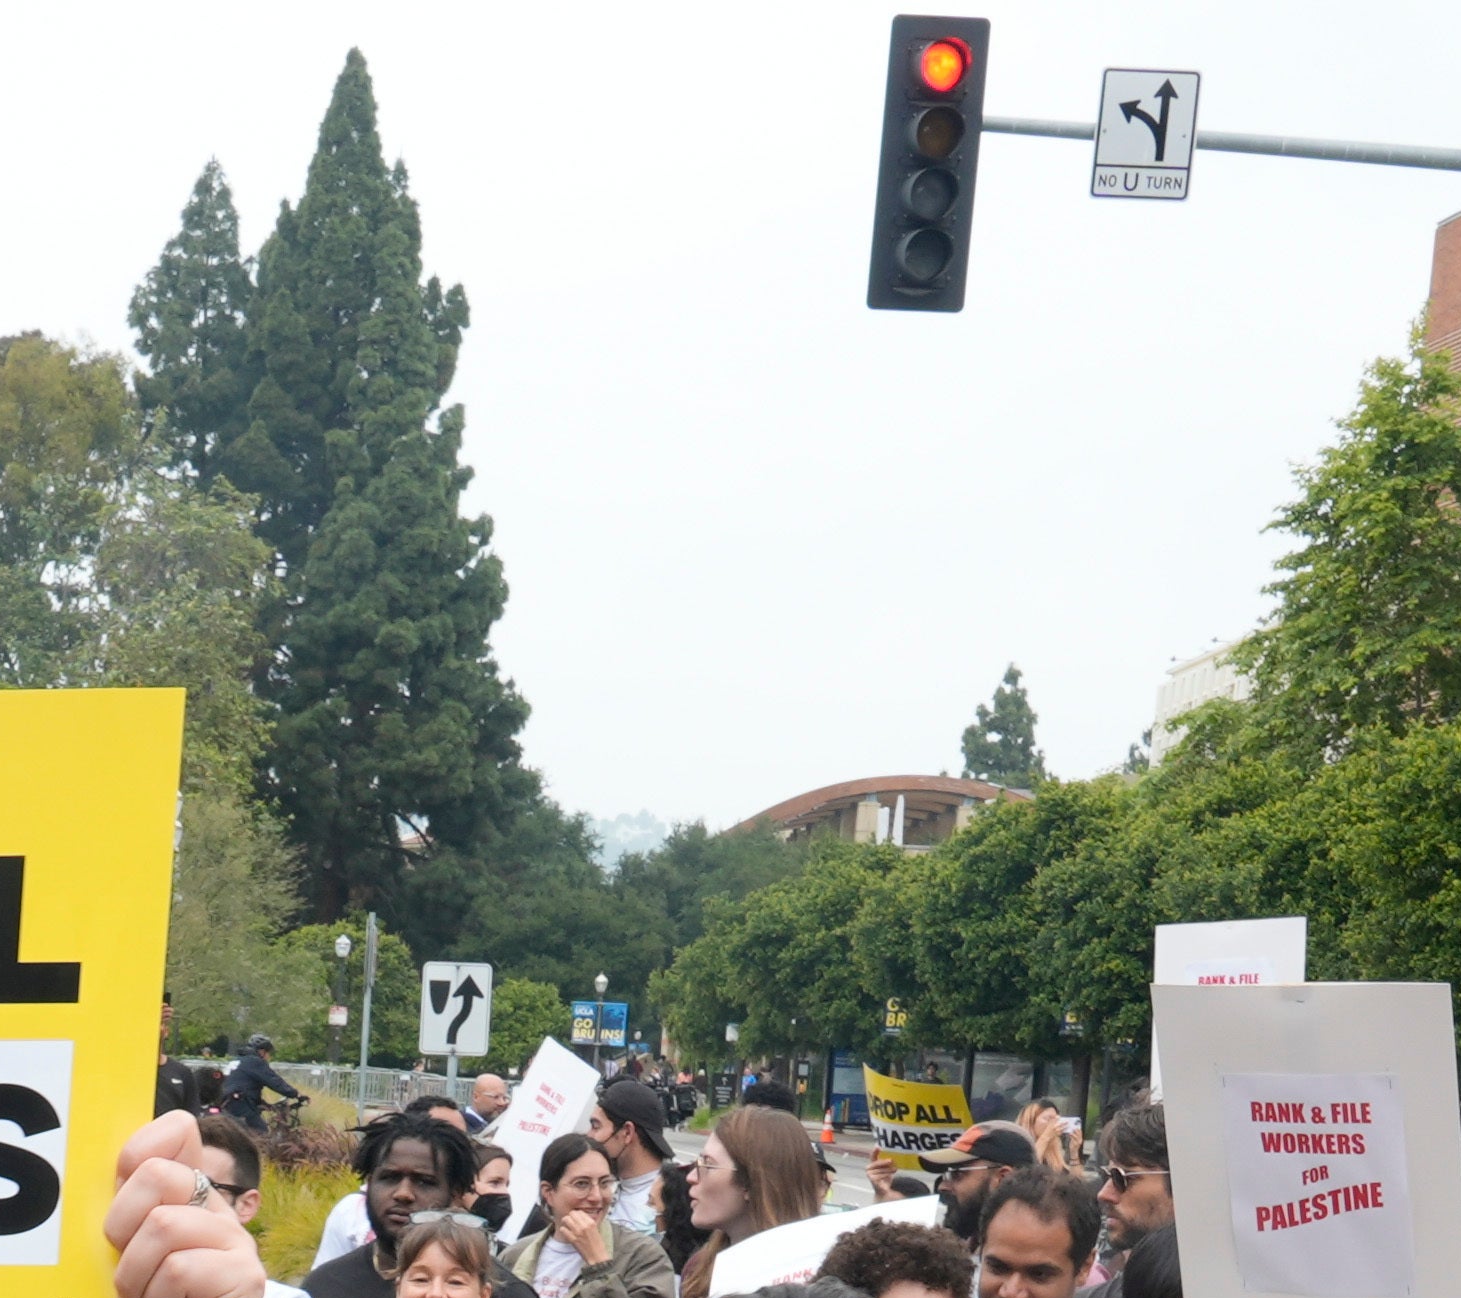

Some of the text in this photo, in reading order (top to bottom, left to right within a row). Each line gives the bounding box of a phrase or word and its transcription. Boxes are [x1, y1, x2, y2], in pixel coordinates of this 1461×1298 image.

[1098, 172, 1183, 192] NO U TURN
[1198, 974, 1225, 985] RANK
[1239, 973, 1260, 984] FILE
[573, 1017, 593, 1029] GO
[867, 1091, 962, 1123] ROP ALL
[1250, 1101, 1372, 1124] RANK & FILE
[876, 1127, 962, 1151] HARGES
[1261, 1132, 1366, 1155] WORKERS
[1302, 1165, 1329, 1186] FOR
[1256, 1182, 1384, 1232] PALESTINE
